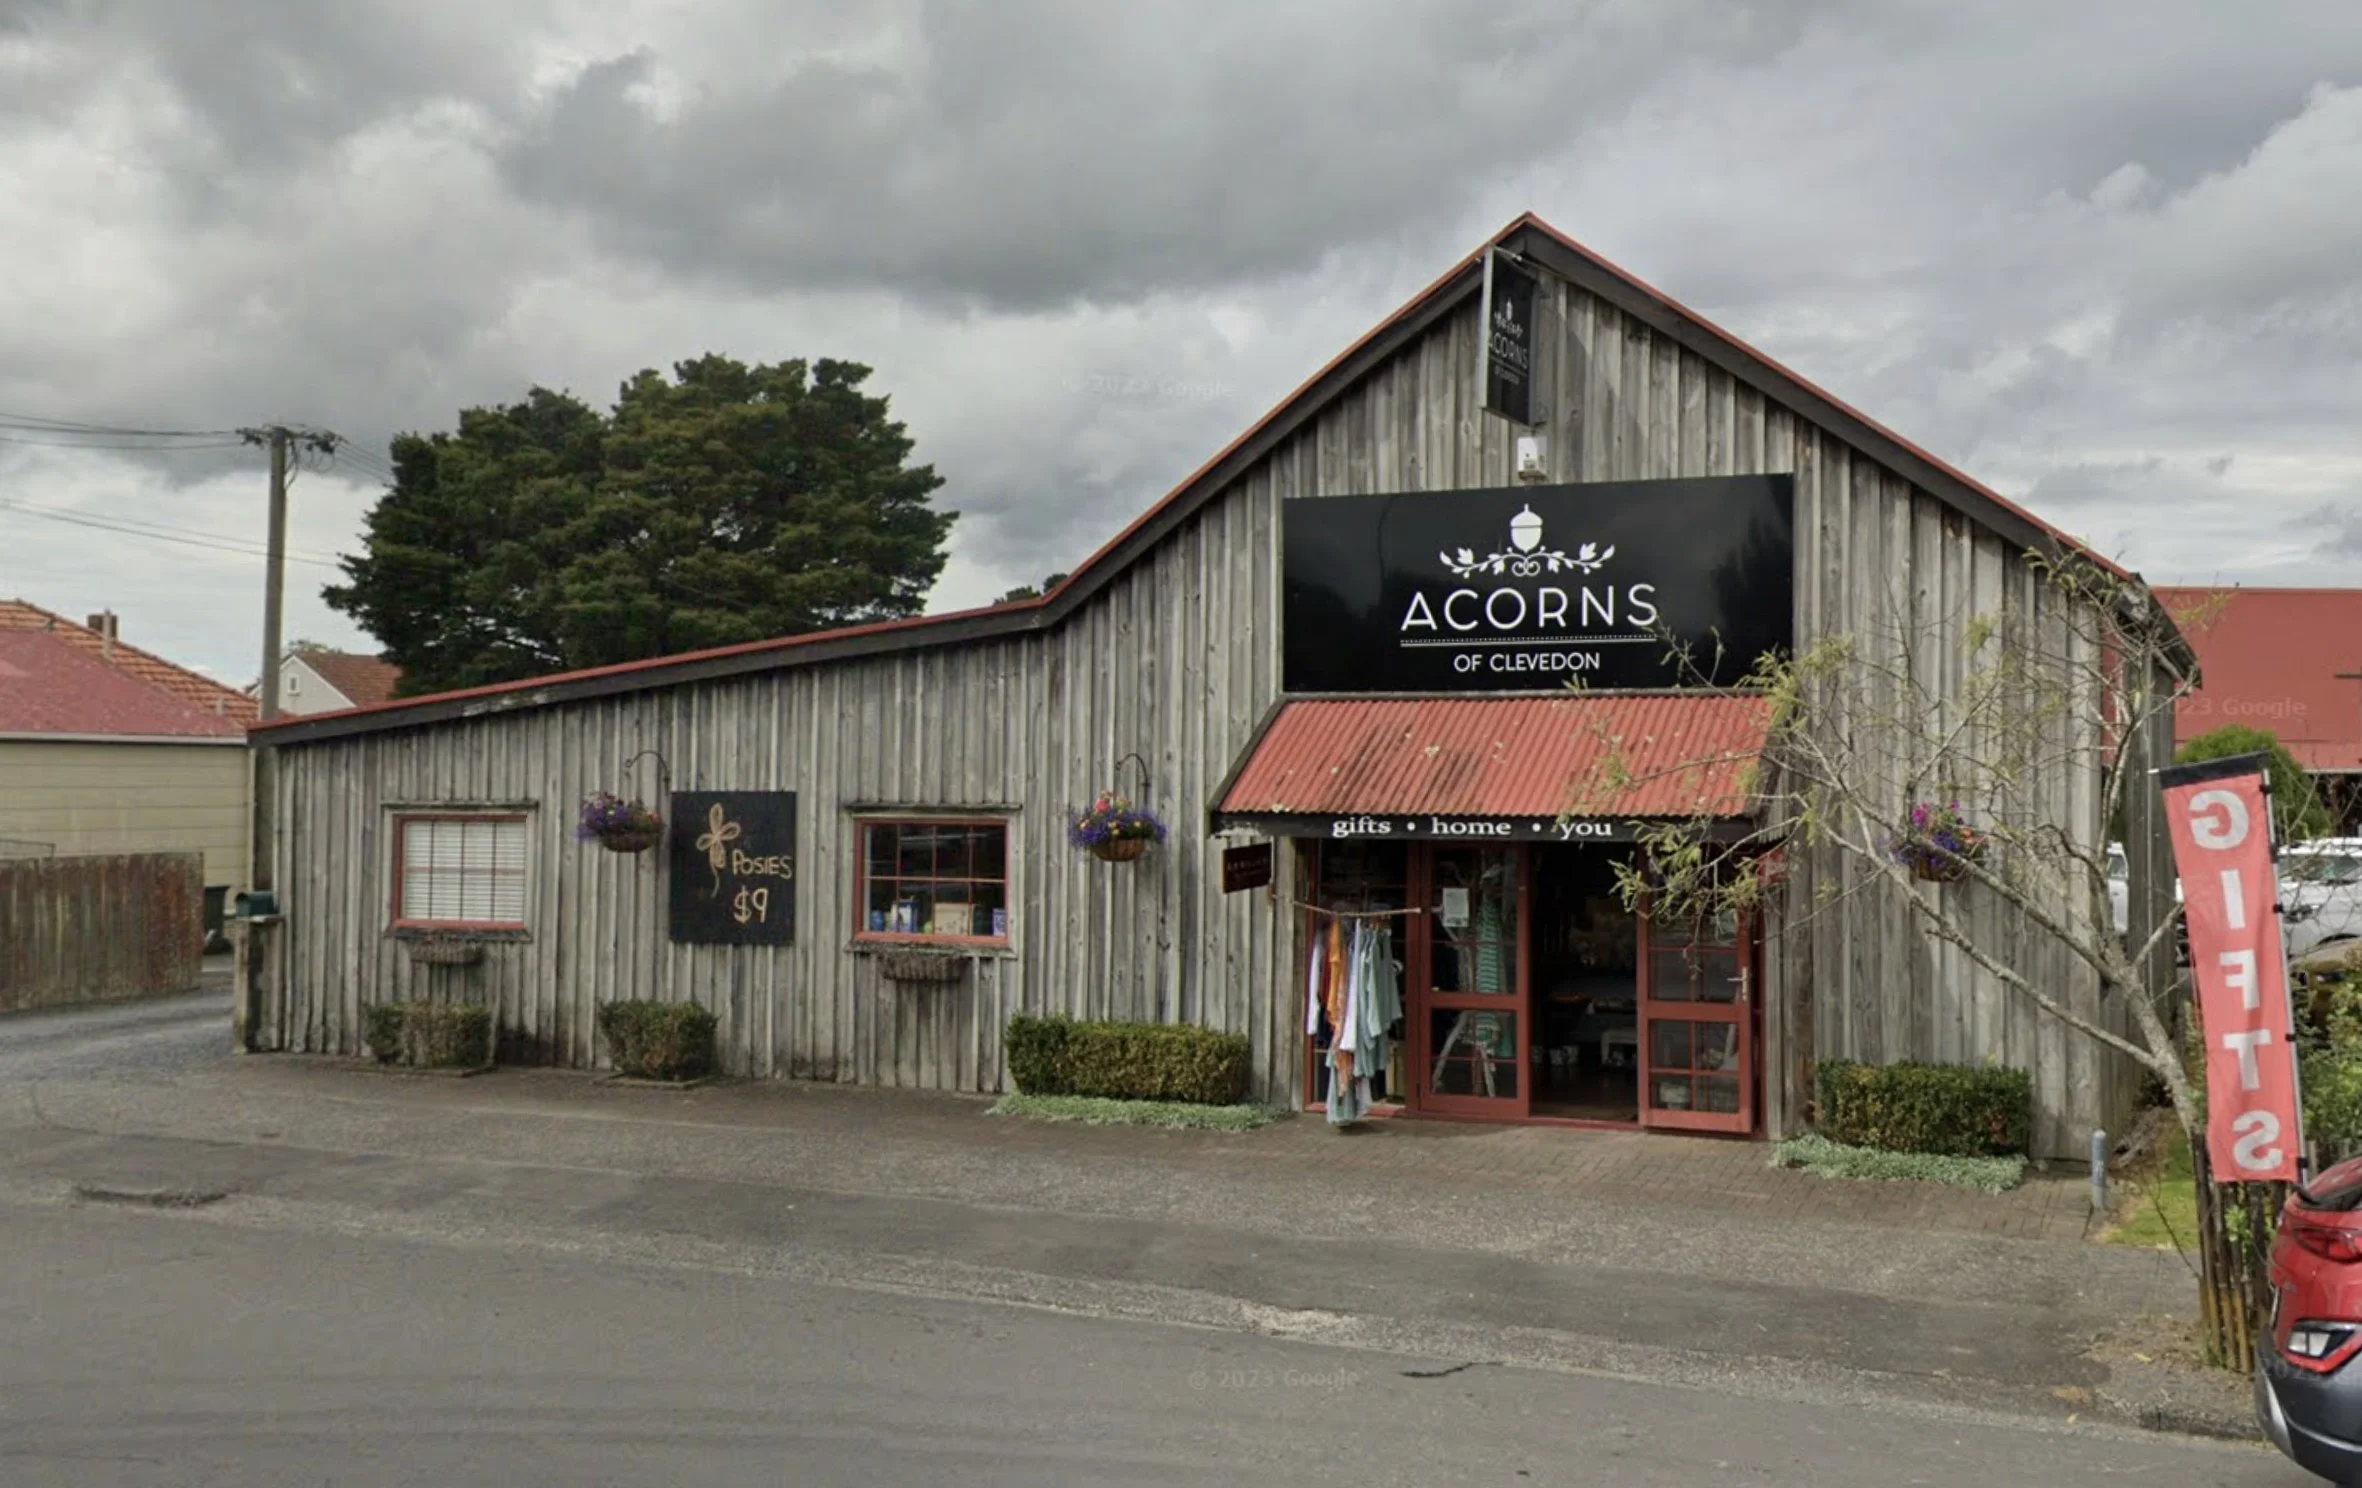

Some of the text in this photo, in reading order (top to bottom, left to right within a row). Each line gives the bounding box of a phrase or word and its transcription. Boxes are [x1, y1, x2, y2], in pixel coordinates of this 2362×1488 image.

[1401, 583, 1657, 632] ACORNS
[1454, 652, 1600, 672] OF CLEVEDON
[1332, 815, 1612, 840] gifts home you
[734, 885, 769, 923] $9
